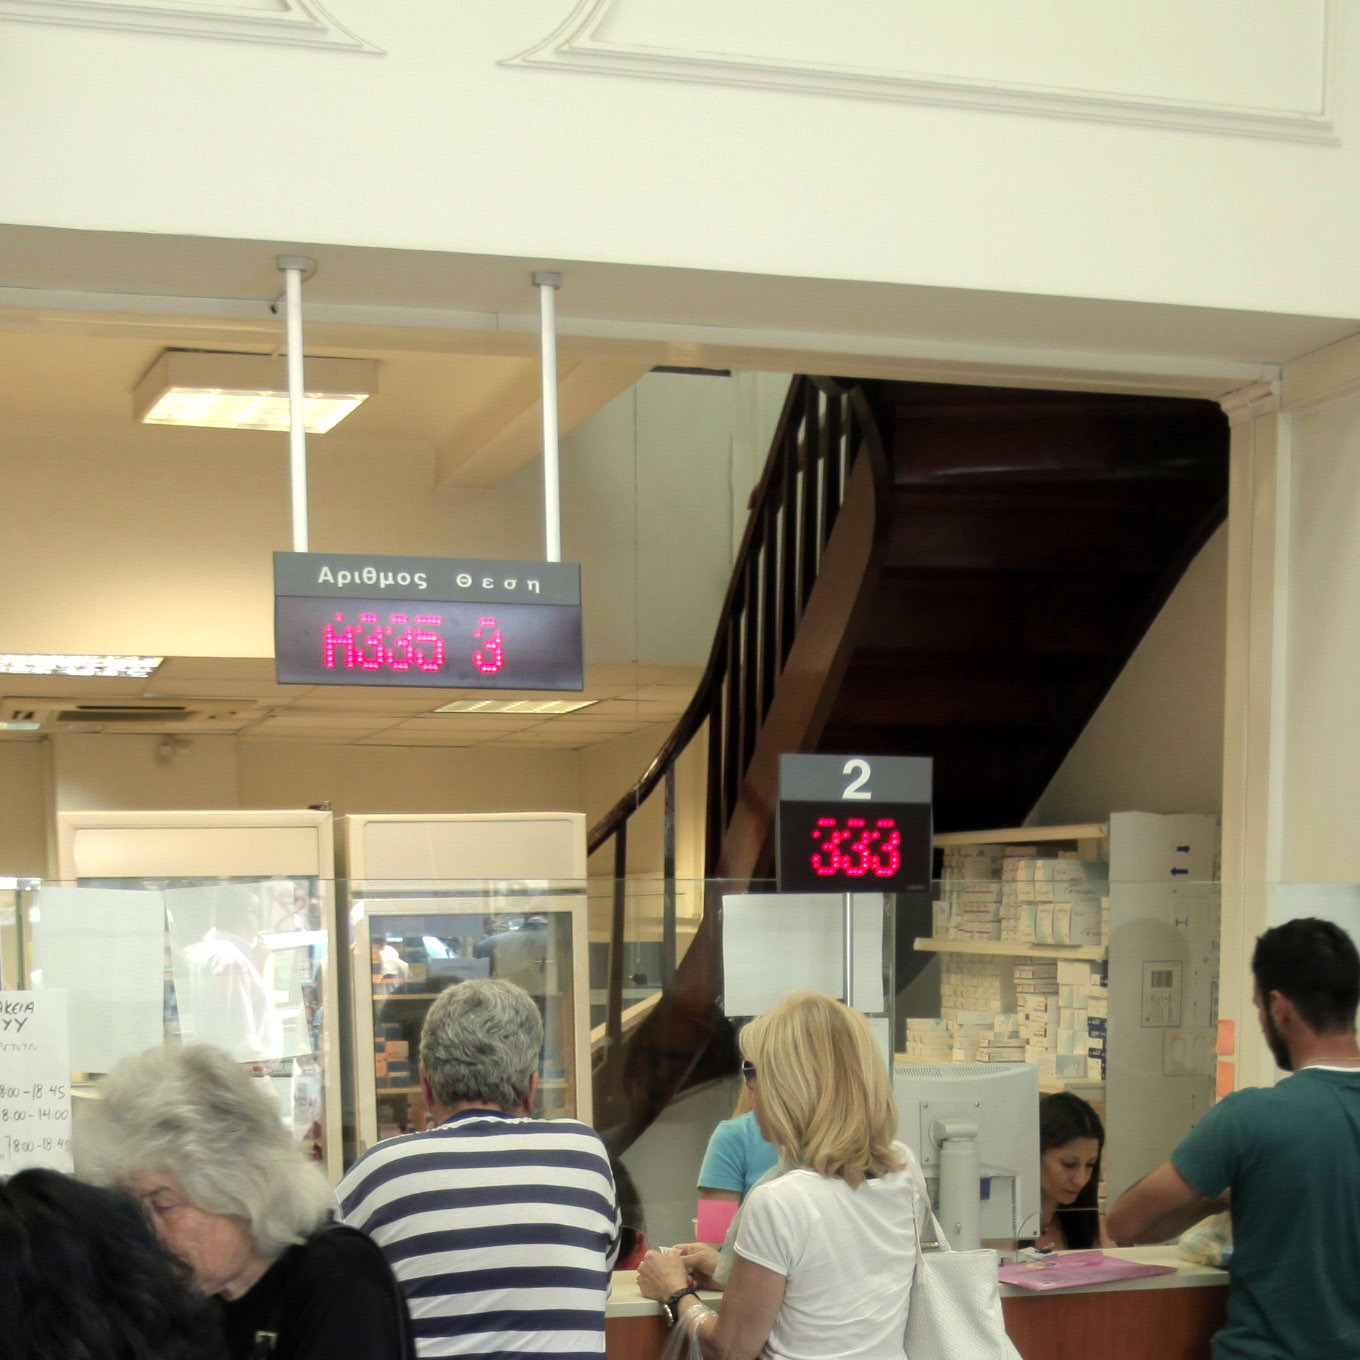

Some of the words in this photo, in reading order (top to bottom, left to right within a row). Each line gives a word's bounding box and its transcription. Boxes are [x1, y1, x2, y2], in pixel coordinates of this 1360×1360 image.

[318, 566, 428, 589] Αριθμος
[474, 616, 504, 674] 3
[842, 759, 872, 800] 2
[811, 817, 900, 877] 333
